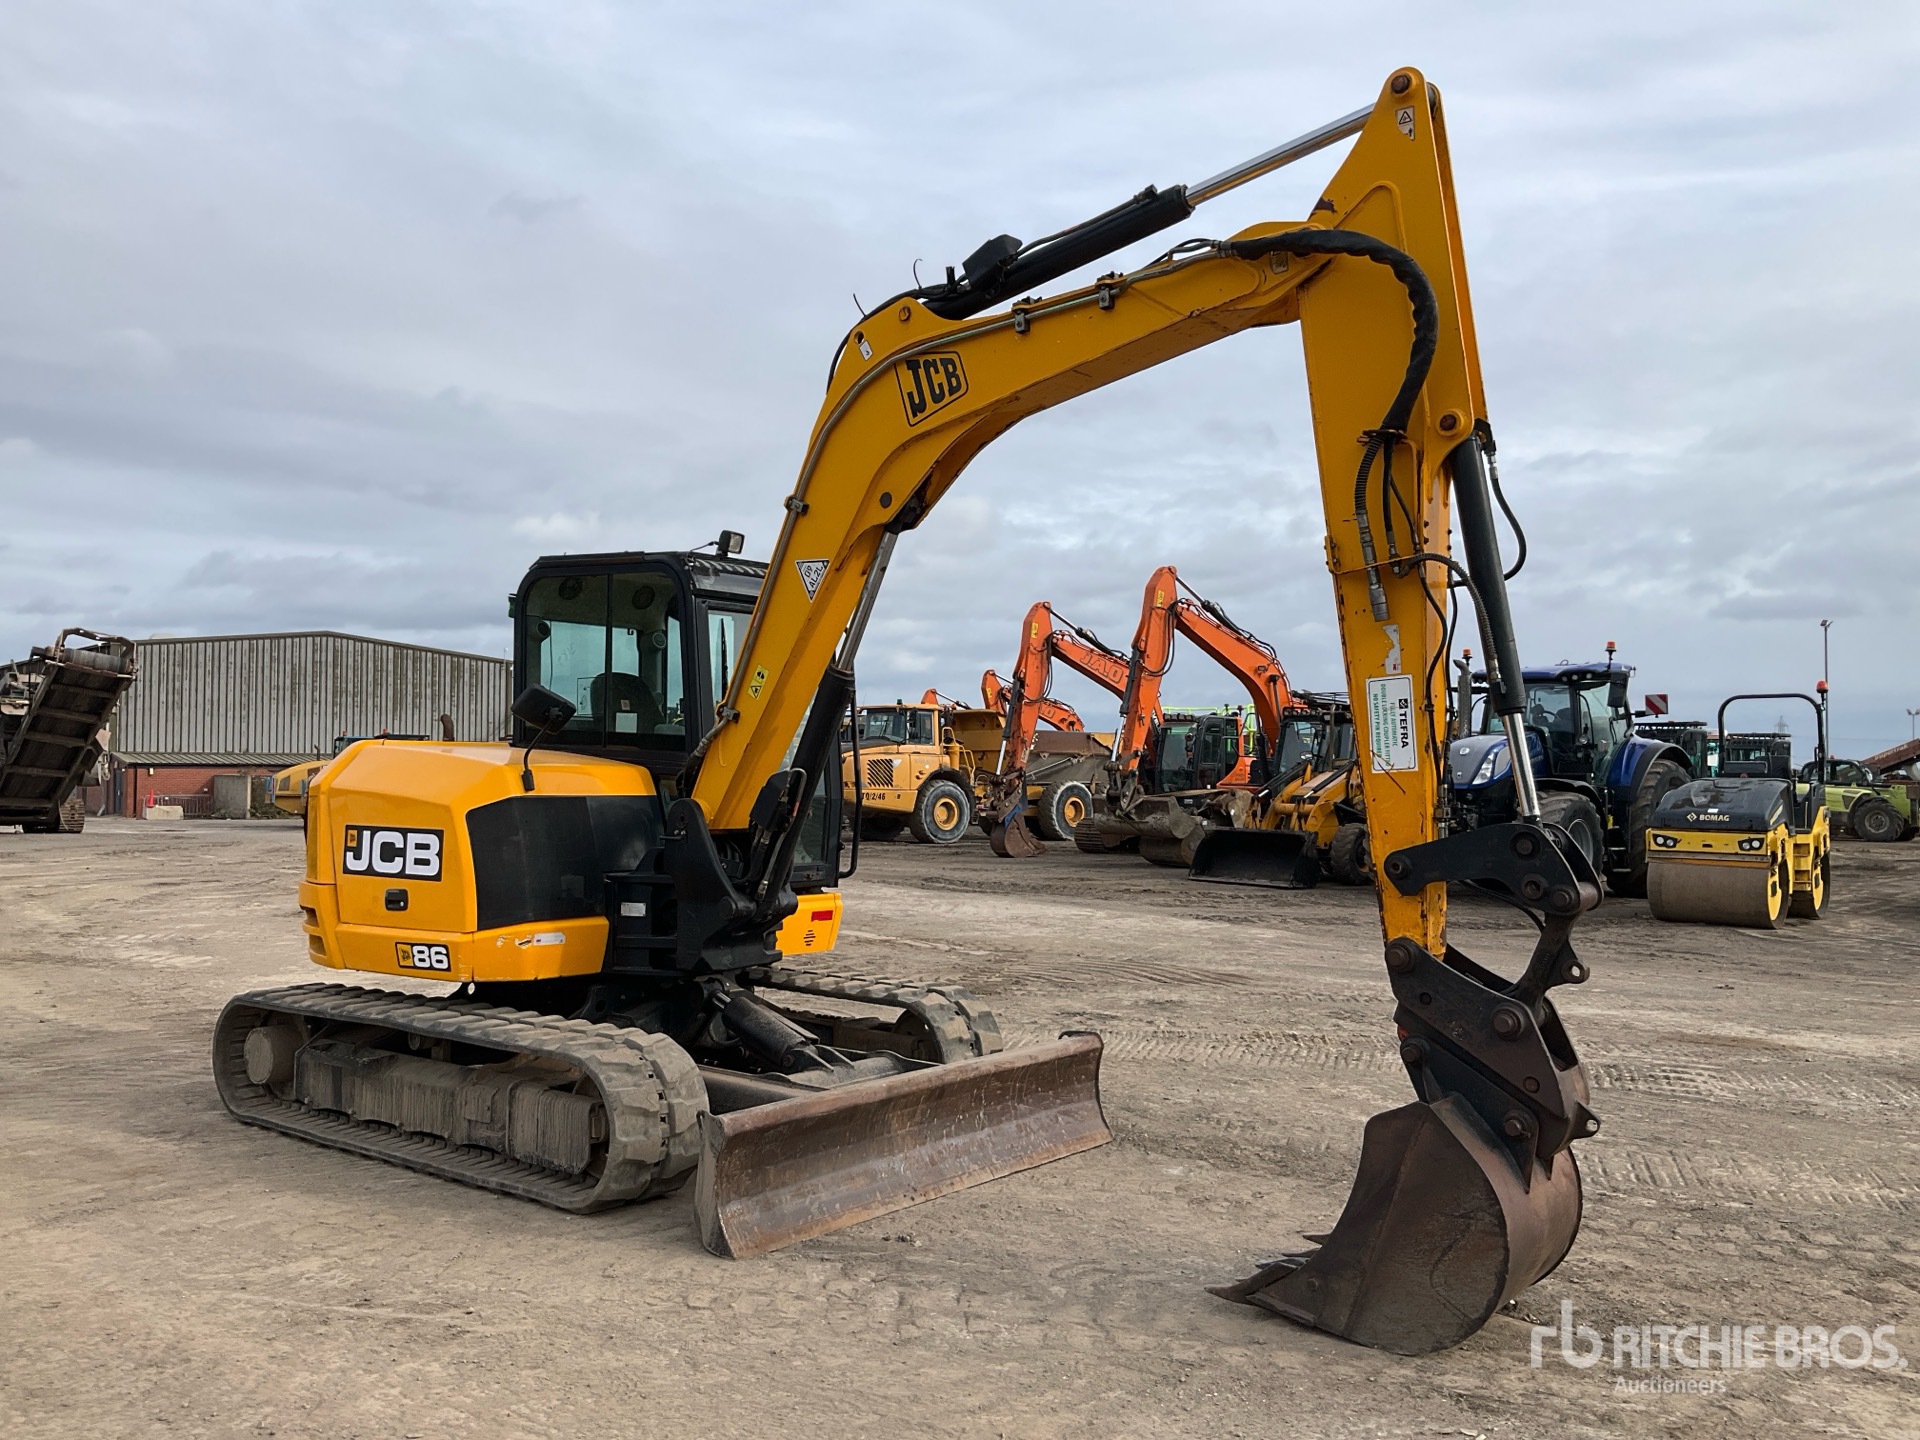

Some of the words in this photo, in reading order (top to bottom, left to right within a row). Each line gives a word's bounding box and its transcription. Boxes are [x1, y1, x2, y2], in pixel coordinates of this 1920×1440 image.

[905, 357, 962, 418] JCB
[804, 565, 813, 578] 09
[1373, 693, 1379, 701] NO
[1380, 683, 1388, 704] DOUBLE
[1381, 704, 1389, 725] LOCKING
[1390, 718, 1398, 747] AUTOMATIC
[1399, 711, 1409, 748] TEFRA
[1699, 814, 1730, 822] BOMAG
[346, 830, 440, 876] JCB
[412, 945, 449, 969] 86
